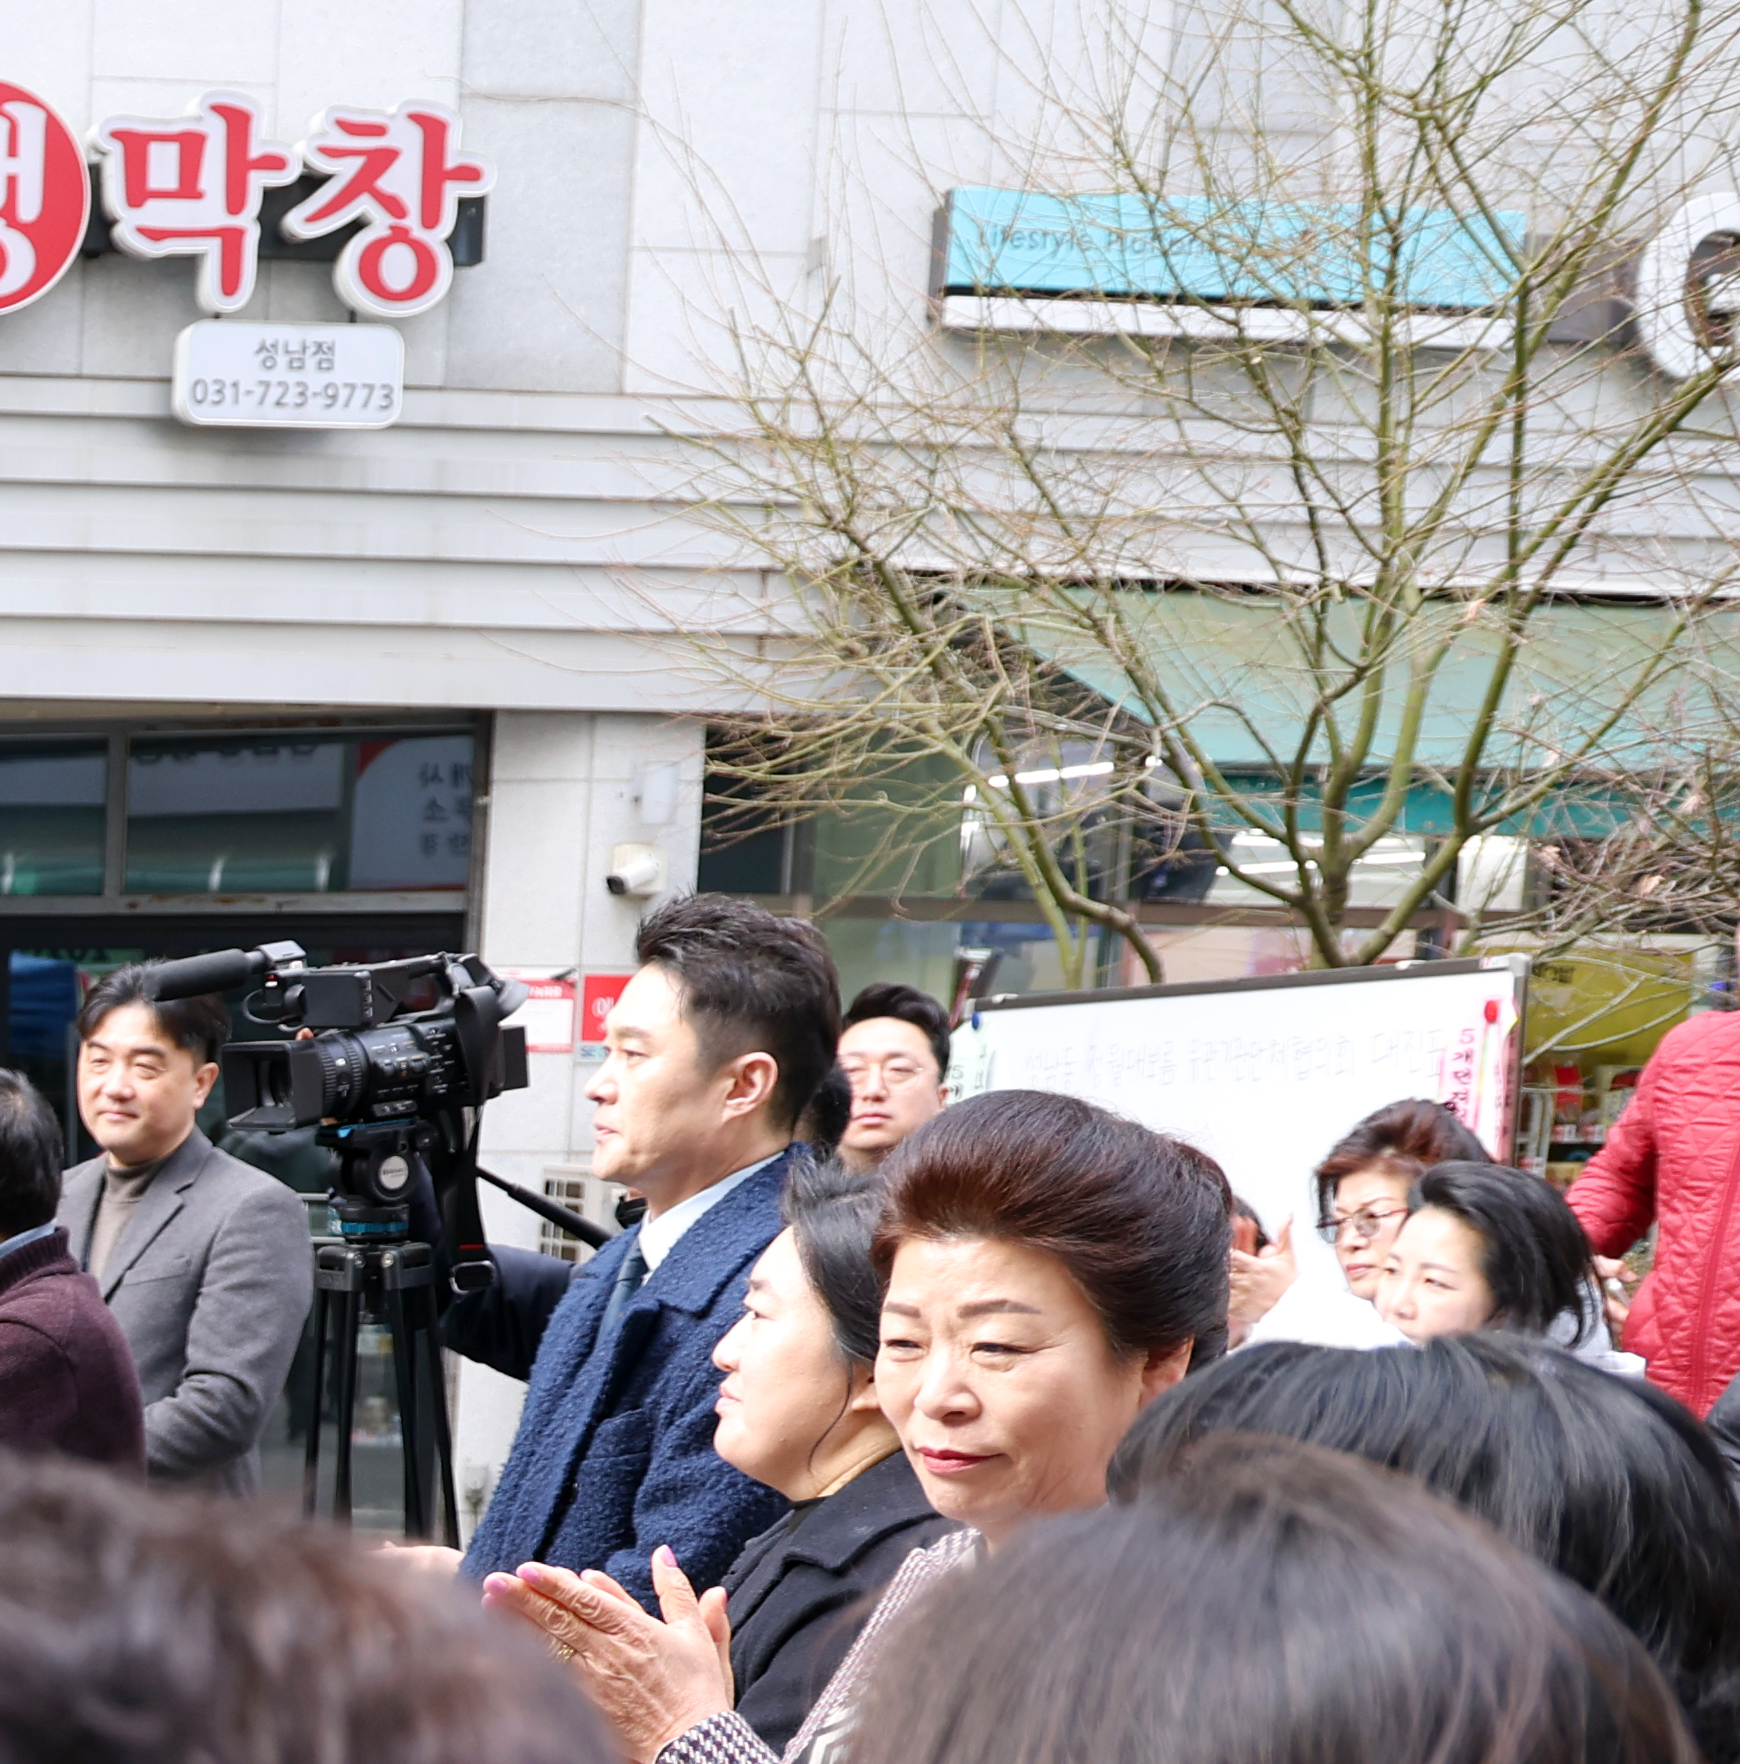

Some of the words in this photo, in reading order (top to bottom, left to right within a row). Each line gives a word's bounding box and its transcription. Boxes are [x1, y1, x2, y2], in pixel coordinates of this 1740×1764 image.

[253, 337, 338, 372] 성남점
[191, 379, 395, 412] 031-723-9773
[1023, 1046, 1077, 1091] 성남동
[1087, 1040, 1178, 1089] 정월대보름
